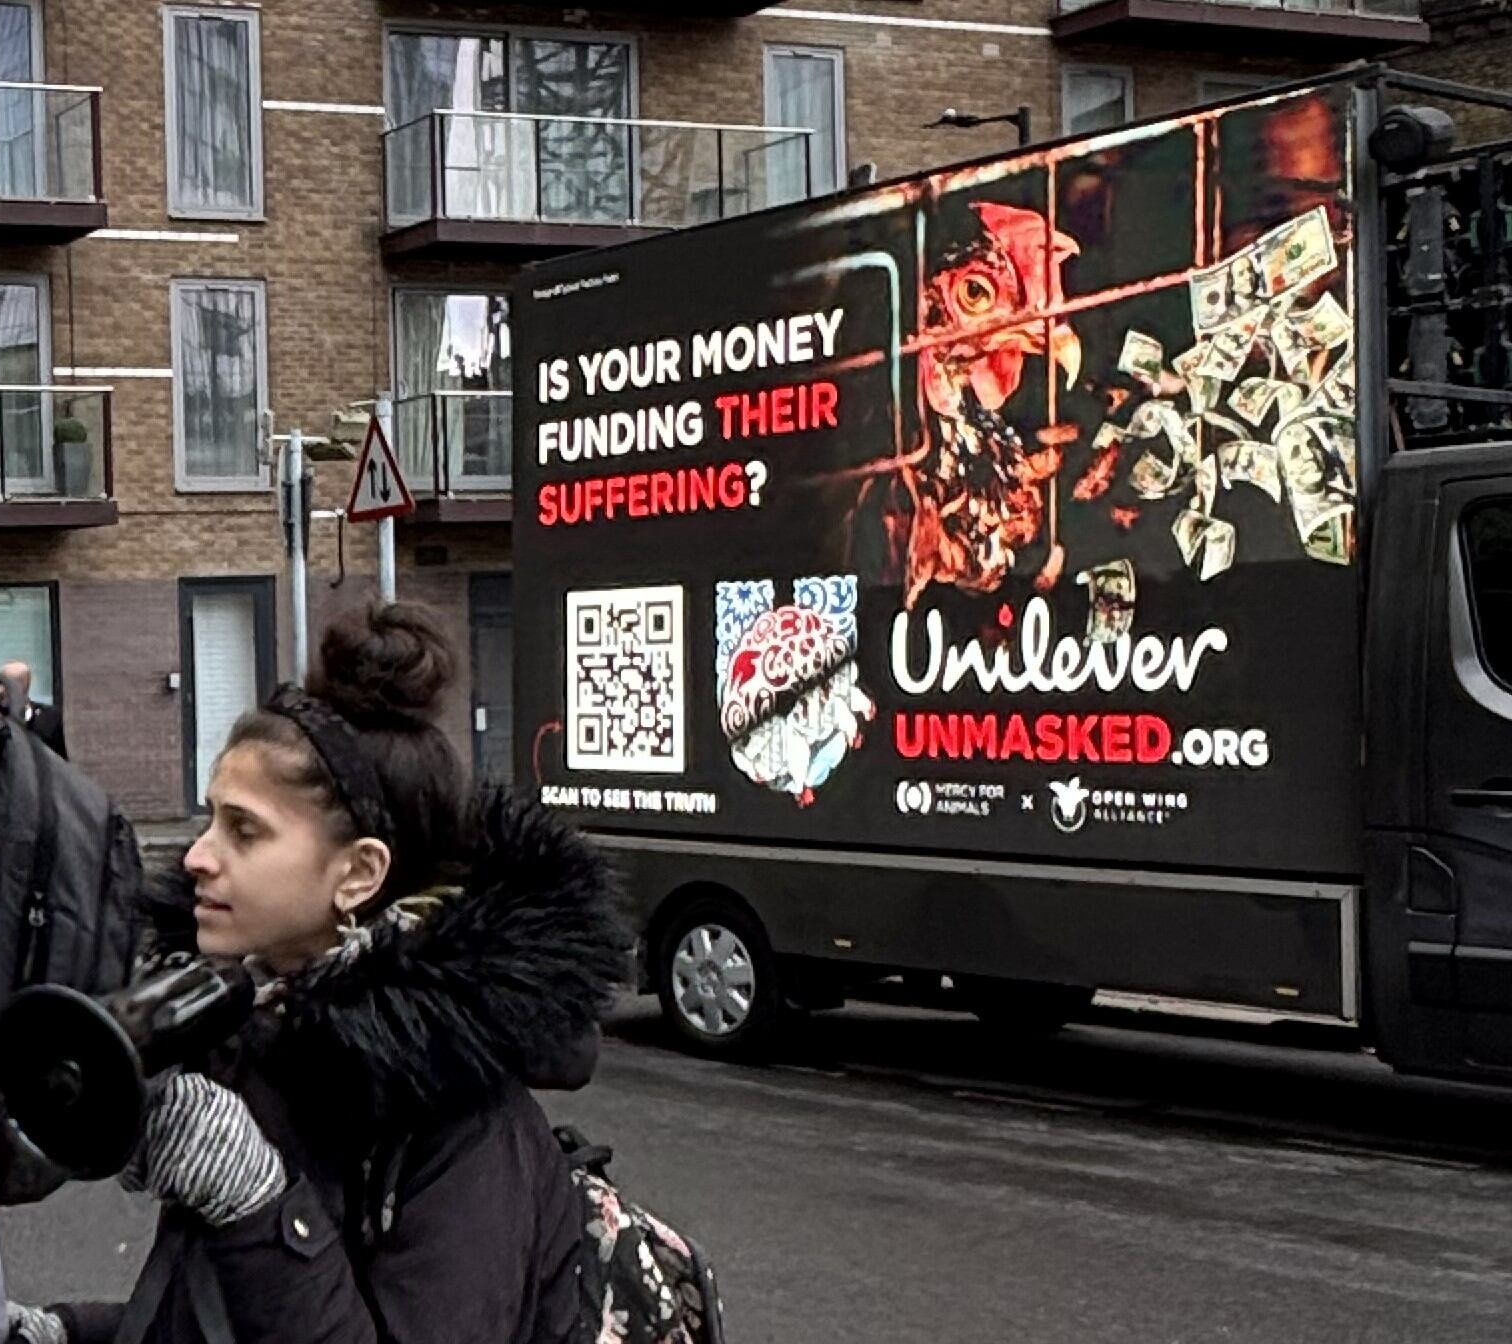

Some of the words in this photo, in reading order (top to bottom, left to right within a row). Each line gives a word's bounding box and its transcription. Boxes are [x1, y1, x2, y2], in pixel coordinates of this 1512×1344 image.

[539, 359, 570, 403] IS
[578, 339, 682, 396] YOUR
[692, 308, 844, 378] MONEY
[538, 401, 704, 465] FUNDING
[715, 382, 838, 439] THEIR
[538, 460, 768, 526] SUFFERING?
[891, 596, 1228, 695] Unilever
[895, 713, 1270, 767] UNMASKED.ORG
[541, 786, 579, 807] SCAN
[581, 787, 601, 808] TO
[603, 788, 630, 809] SEE
[633, 790, 662, 812] THE
[664, 792, 716, 814] TRUTH
[1092, 791, 1136, 807] OPEN
